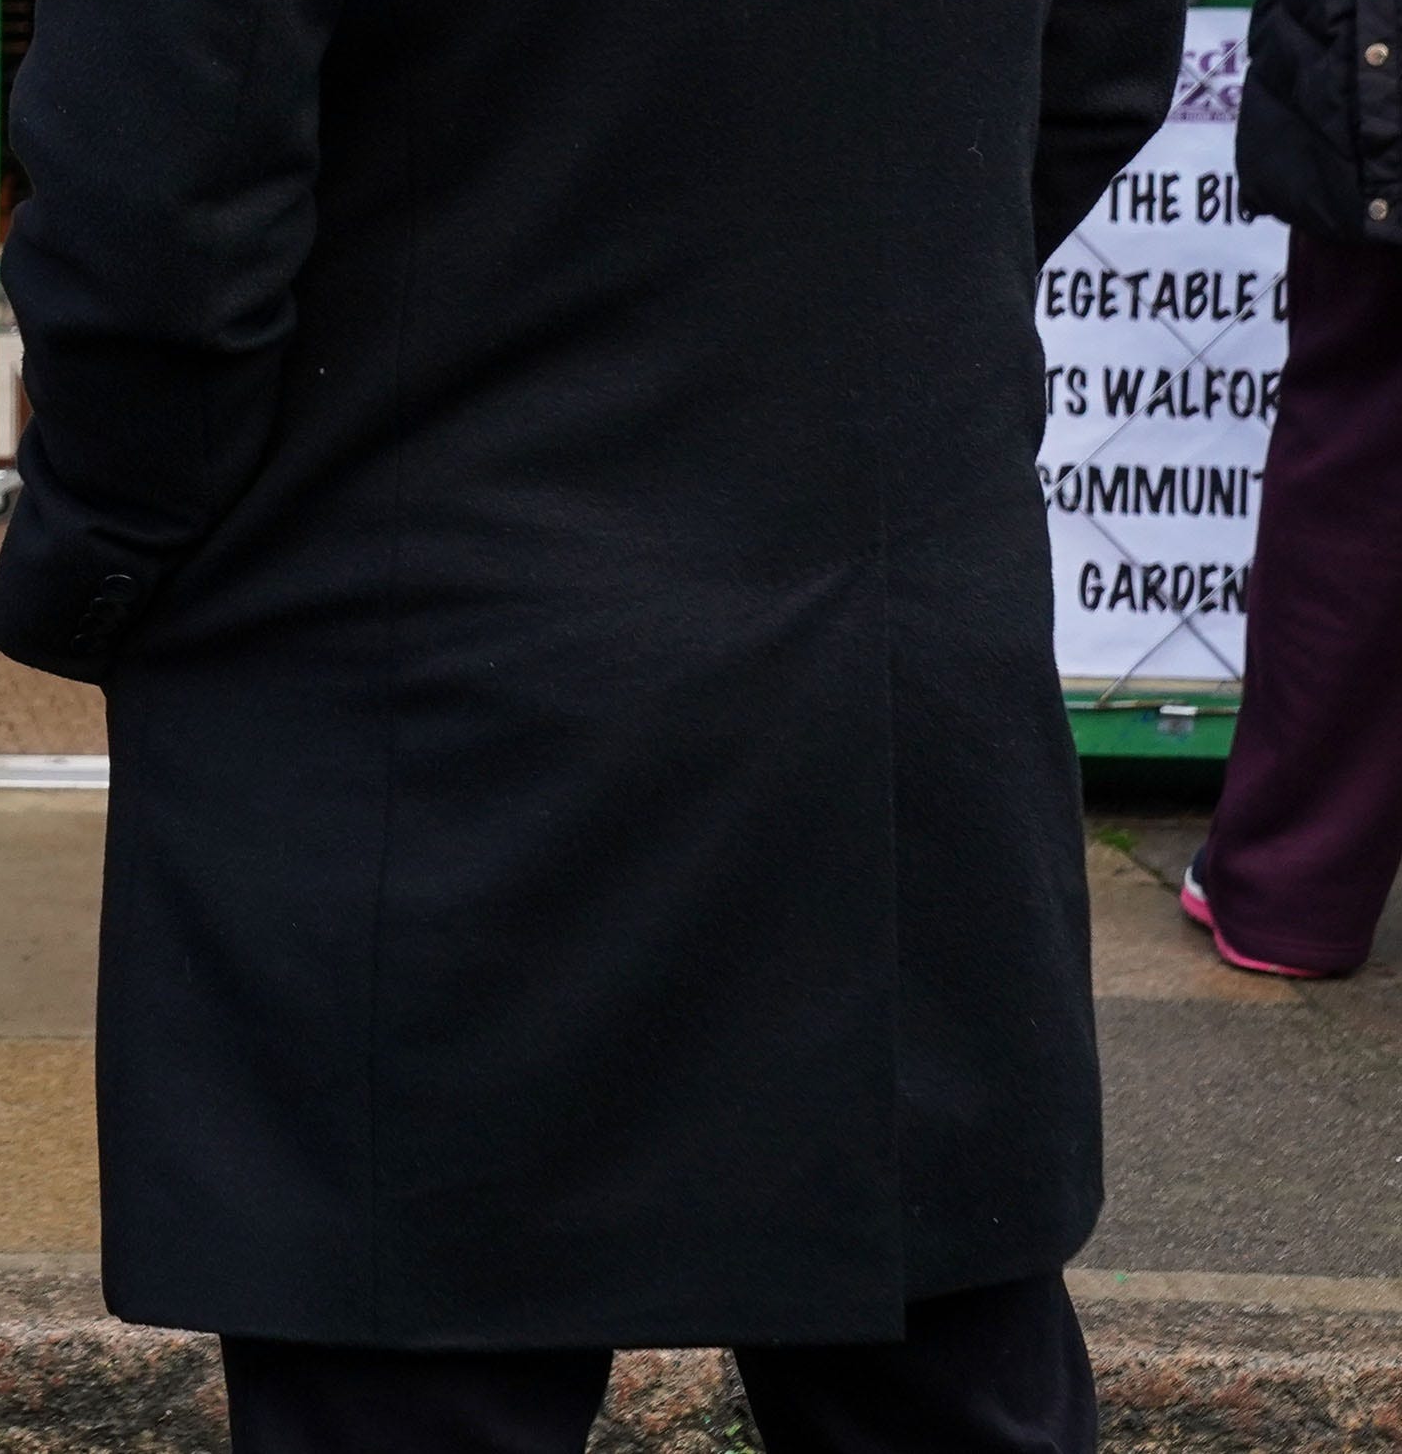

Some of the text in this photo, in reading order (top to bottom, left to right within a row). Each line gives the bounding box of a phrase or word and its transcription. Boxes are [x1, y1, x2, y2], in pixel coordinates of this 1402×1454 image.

[1107, 171, 1255, 226] THE BI
[1044, 269, 1258, 324] EGETABLE
[1103, 365, 1282, 421] WALFOR
[1036, 463, 1264, 518] OMMUNI
[1078, 561, 1250, 614] GARDEN
